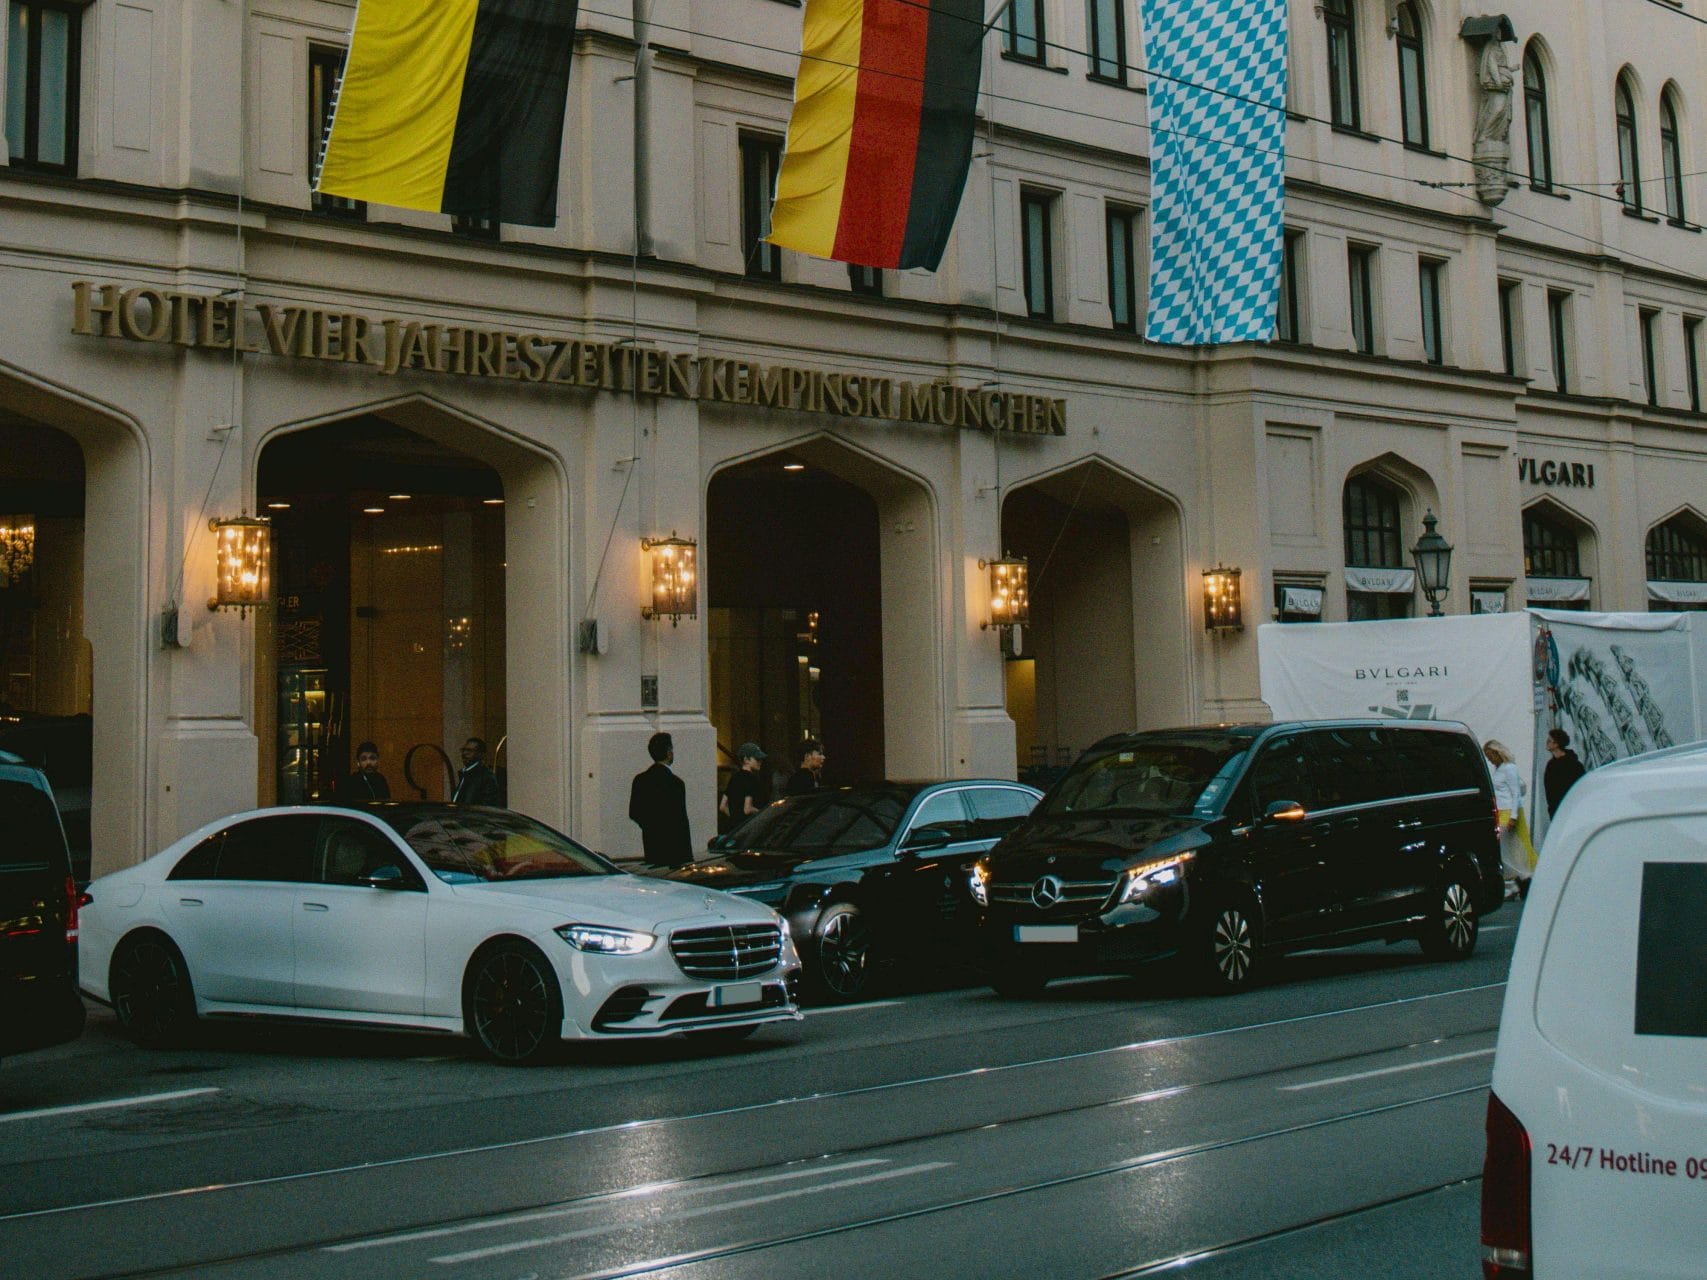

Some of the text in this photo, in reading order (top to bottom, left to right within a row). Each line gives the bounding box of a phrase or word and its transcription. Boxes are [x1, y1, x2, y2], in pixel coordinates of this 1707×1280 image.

[72, 280, 1067, 435] HOTEL VIER JAHRESZEITEN KEMPINSKI MÜNCHEN
[1355, 666, 1448, 680] BVLGARI
[1547, 1143, 1593, 1169] 24/7
[1600, 1148, 1677, 1176] Hotline
